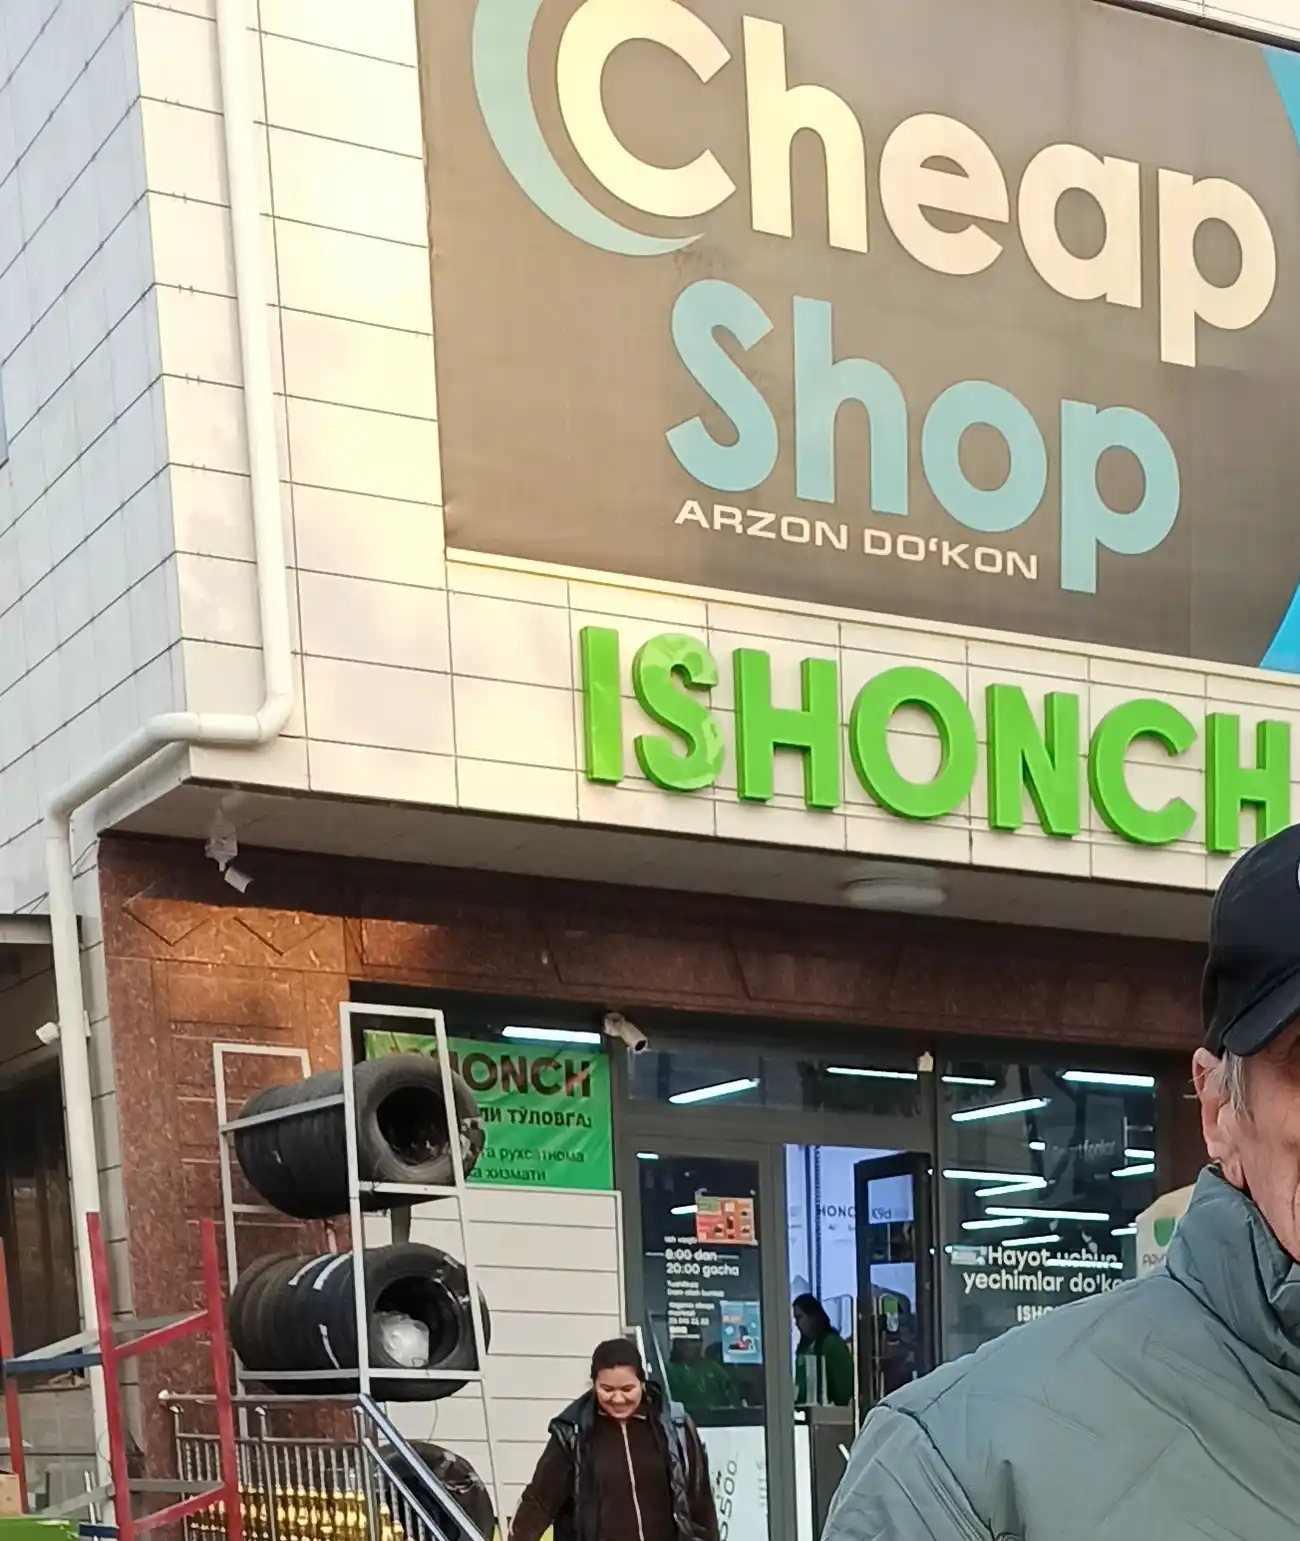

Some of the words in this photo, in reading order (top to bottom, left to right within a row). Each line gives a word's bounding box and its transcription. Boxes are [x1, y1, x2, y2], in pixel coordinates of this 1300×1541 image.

[556, 0, 1278, 367] Cheap
[665, 279, 1181, 594] Shop
[673, 500, 849, 552] ARZON
[580, 625, 1291, 853] ISHONCH
[430, 1049, 592, 1098] ONCH
[666, 1262, 700, 1274] 20:00
[962, 1268, 1065, 1294] yechimlar
[1069, 1272, 1122, 1293] do'ko
[988, 1245, 1051, 1271] Hayot
